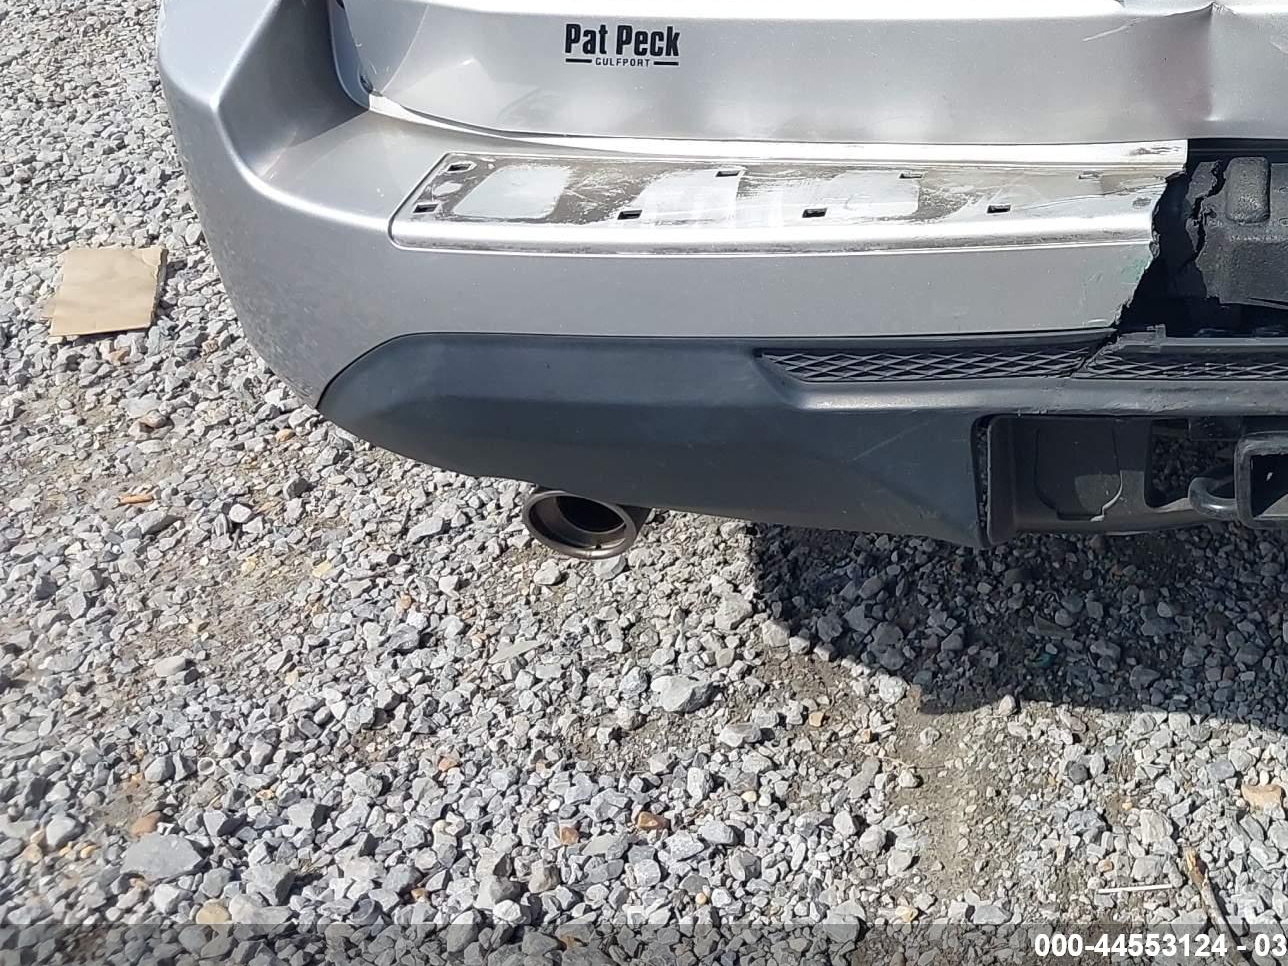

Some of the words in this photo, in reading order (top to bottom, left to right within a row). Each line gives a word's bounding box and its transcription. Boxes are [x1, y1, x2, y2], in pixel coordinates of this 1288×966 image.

[565, 23, 608, 55] Pat
[616, 24, 681, 57] Peck
[595, 57, 651, 68] GULFPORT
